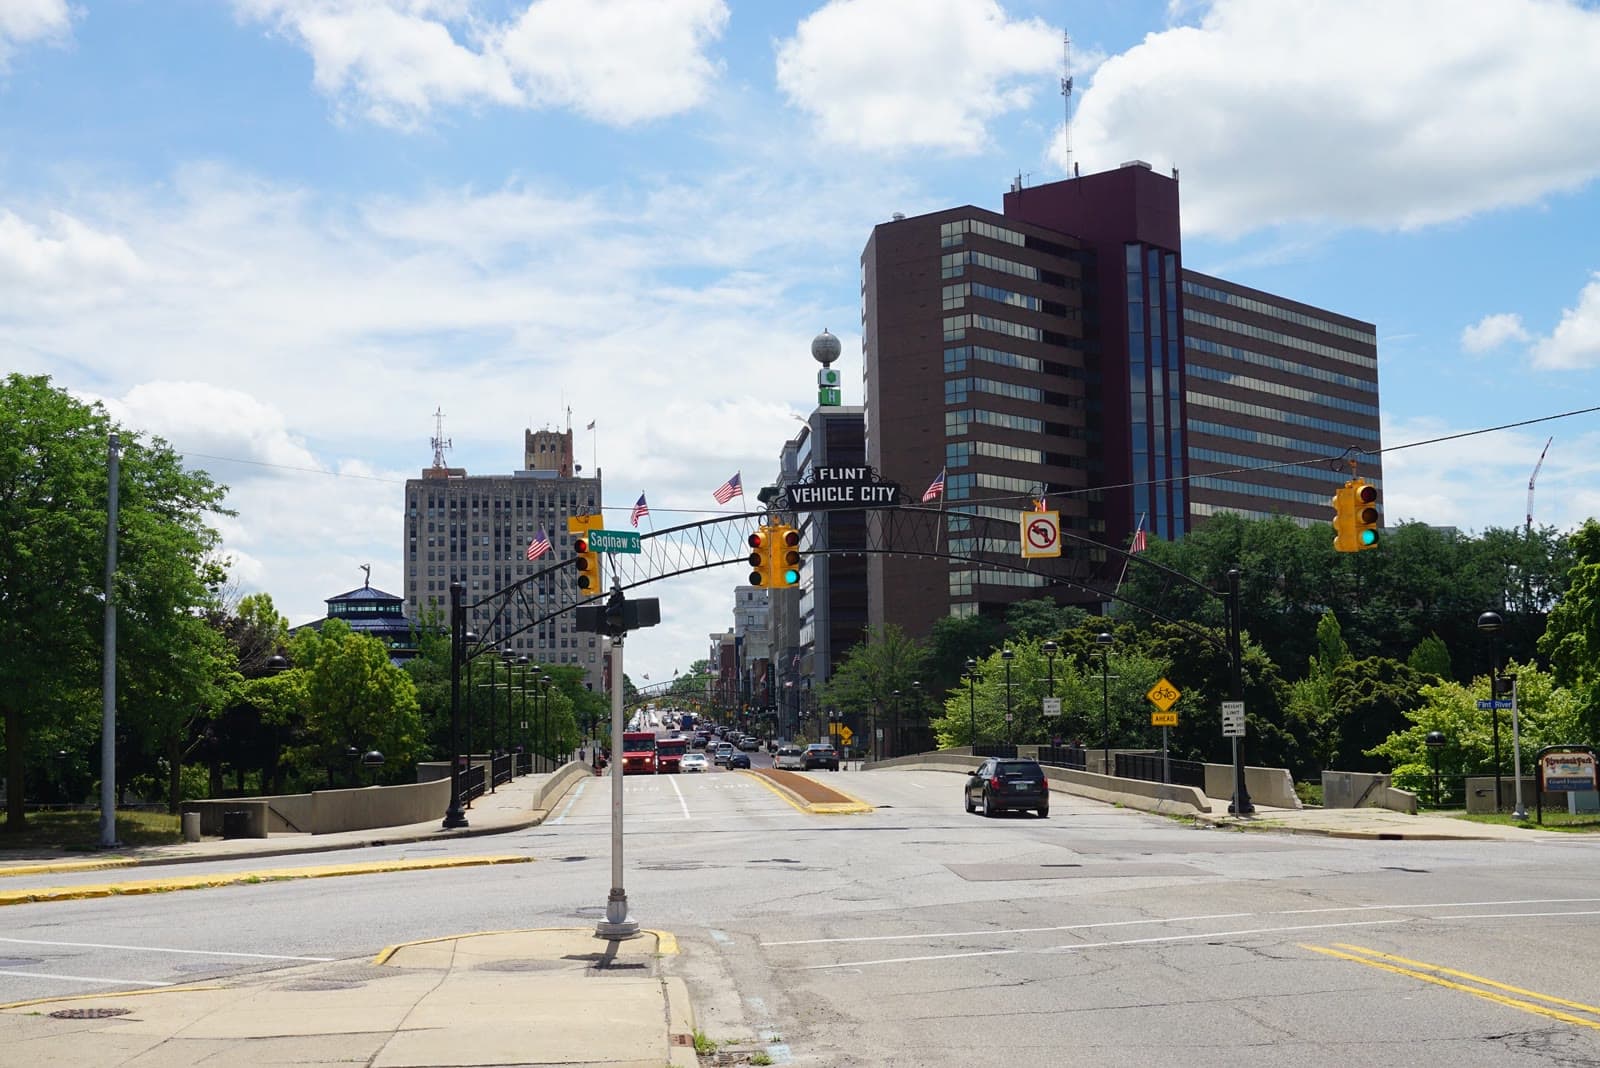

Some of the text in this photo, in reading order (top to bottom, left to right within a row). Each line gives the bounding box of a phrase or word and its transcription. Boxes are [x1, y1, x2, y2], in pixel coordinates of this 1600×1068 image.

[820, 468, 867, 480] FLINT
[792, 486, 895, 503] VEHICLE CITY
[591, 532, 640, 551] Saginaw St
[1478, 701, 1512, 709] Flint River
[1154, 714, 1176, 722] AHEAD
